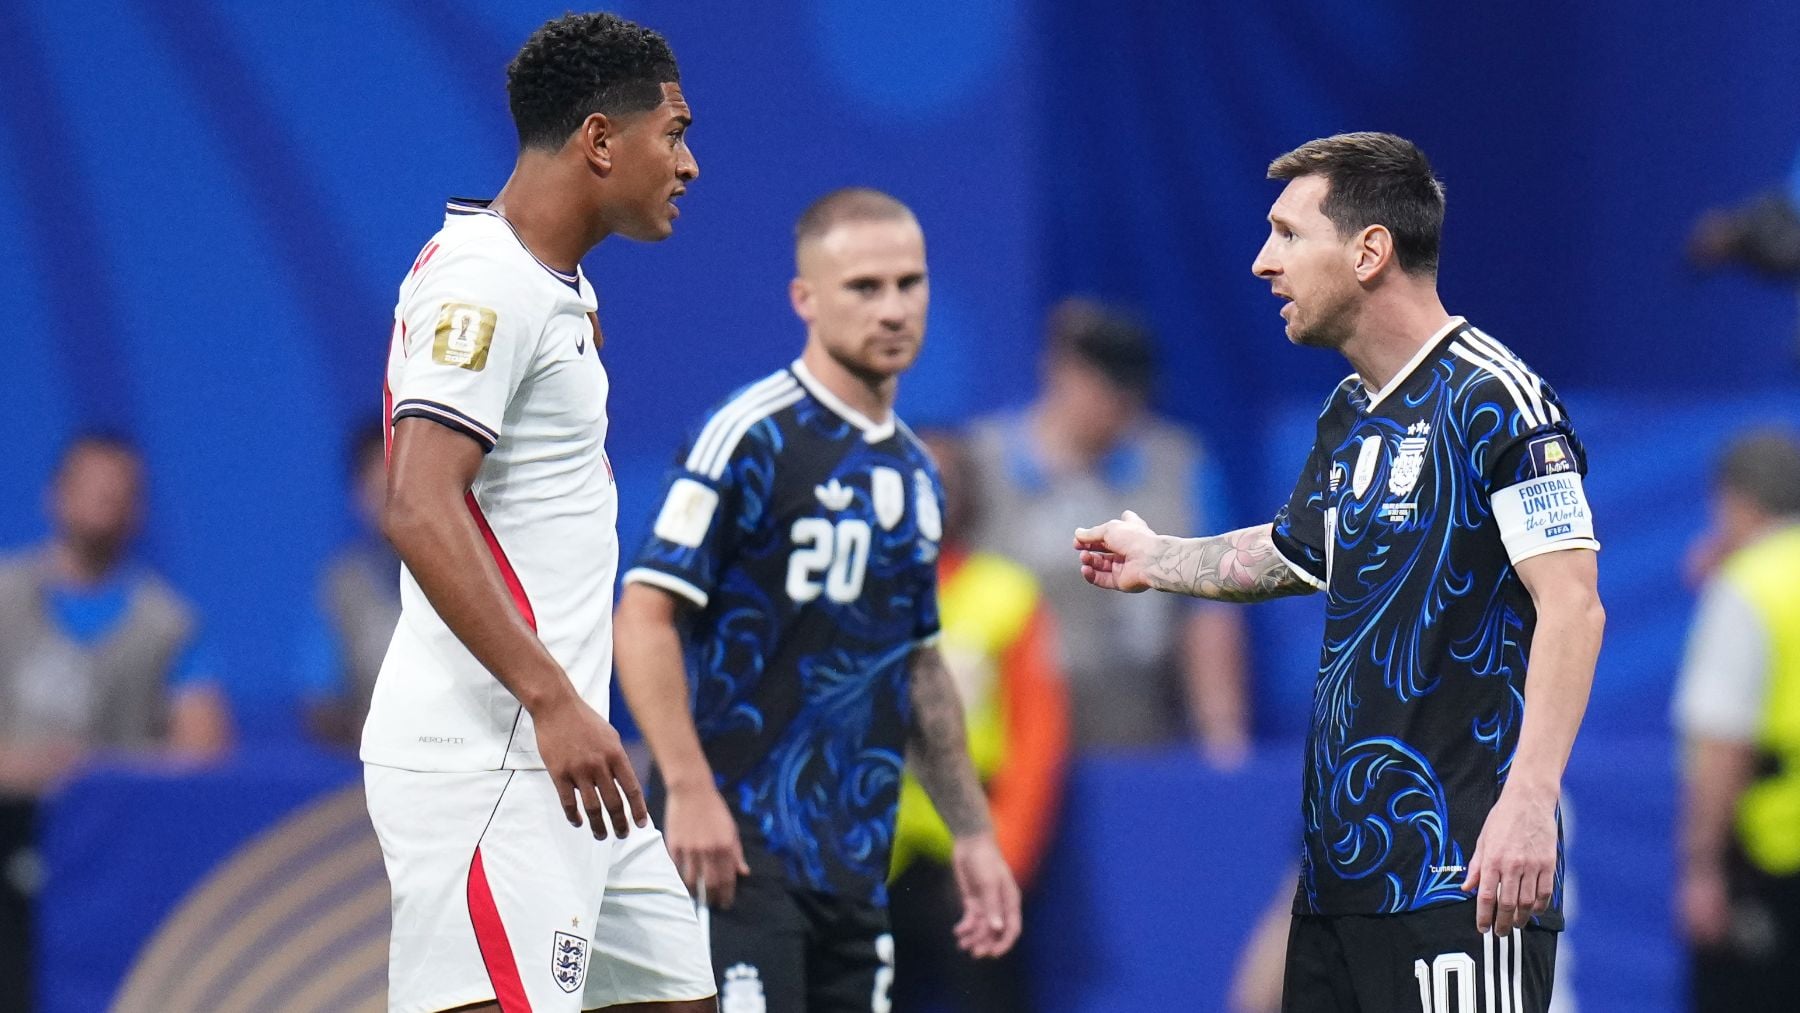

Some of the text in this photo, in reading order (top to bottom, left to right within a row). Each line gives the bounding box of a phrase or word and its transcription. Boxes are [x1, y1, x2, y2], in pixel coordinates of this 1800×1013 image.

[1518, 478, 1574, 500] FOOTBALL
[1522, 490, 1579, 515] UNITES
[1525, 506, 1584, 531] the World
[1546, 524, 1571, 537] FIFA
[785, 517, 872, 604] 20
[1414, 951, 1478, 1013] 10
